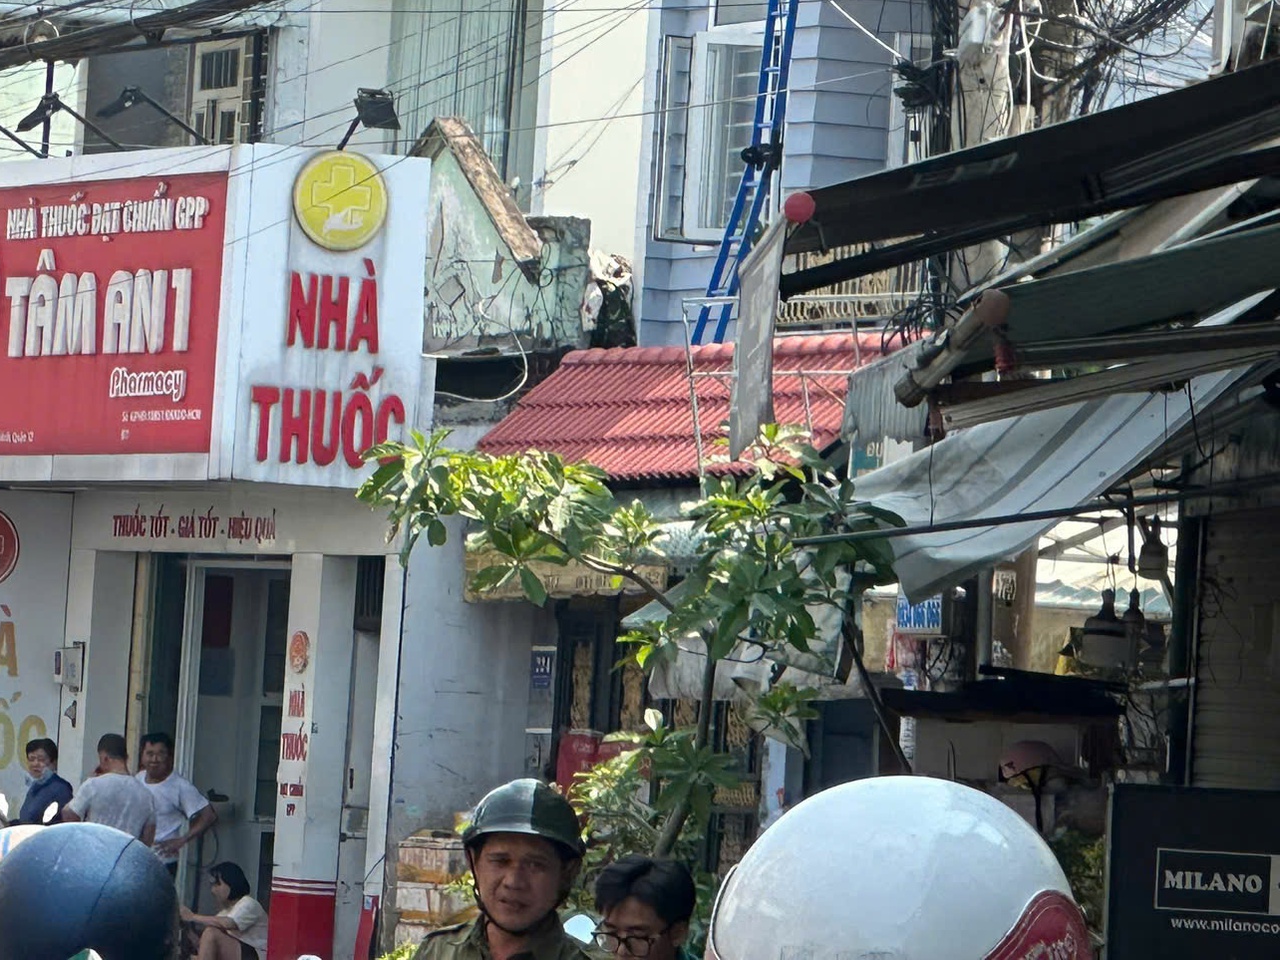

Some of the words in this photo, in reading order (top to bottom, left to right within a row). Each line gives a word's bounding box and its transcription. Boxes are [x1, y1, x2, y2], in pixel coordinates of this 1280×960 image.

[7, 197, 37, 240] NHÀ
[40, 191, 90, 238] THUỐC
[91, 202, 121, 242] ĐẠT
[122, 182, 173, 233] CHUẨN
[175, 196, 210, 229] GPP
[4, 248, 97, 358] TÂM
[285, 257, 379, 354] NHÀ
[109, 366, 186, 402] Pharmacy
[251, 366, 405, 470] THUỐC
[113, 503, 146, 537] THUỐC
[150, 504, 170, 538] TỐT
[178, 508, 195, 538] GIÁ
[198, 506, 219, 538] TỐT
[1164, 869, 1263, 893] MILANO
[1170, 918, 1280, 934] www.milanoco
